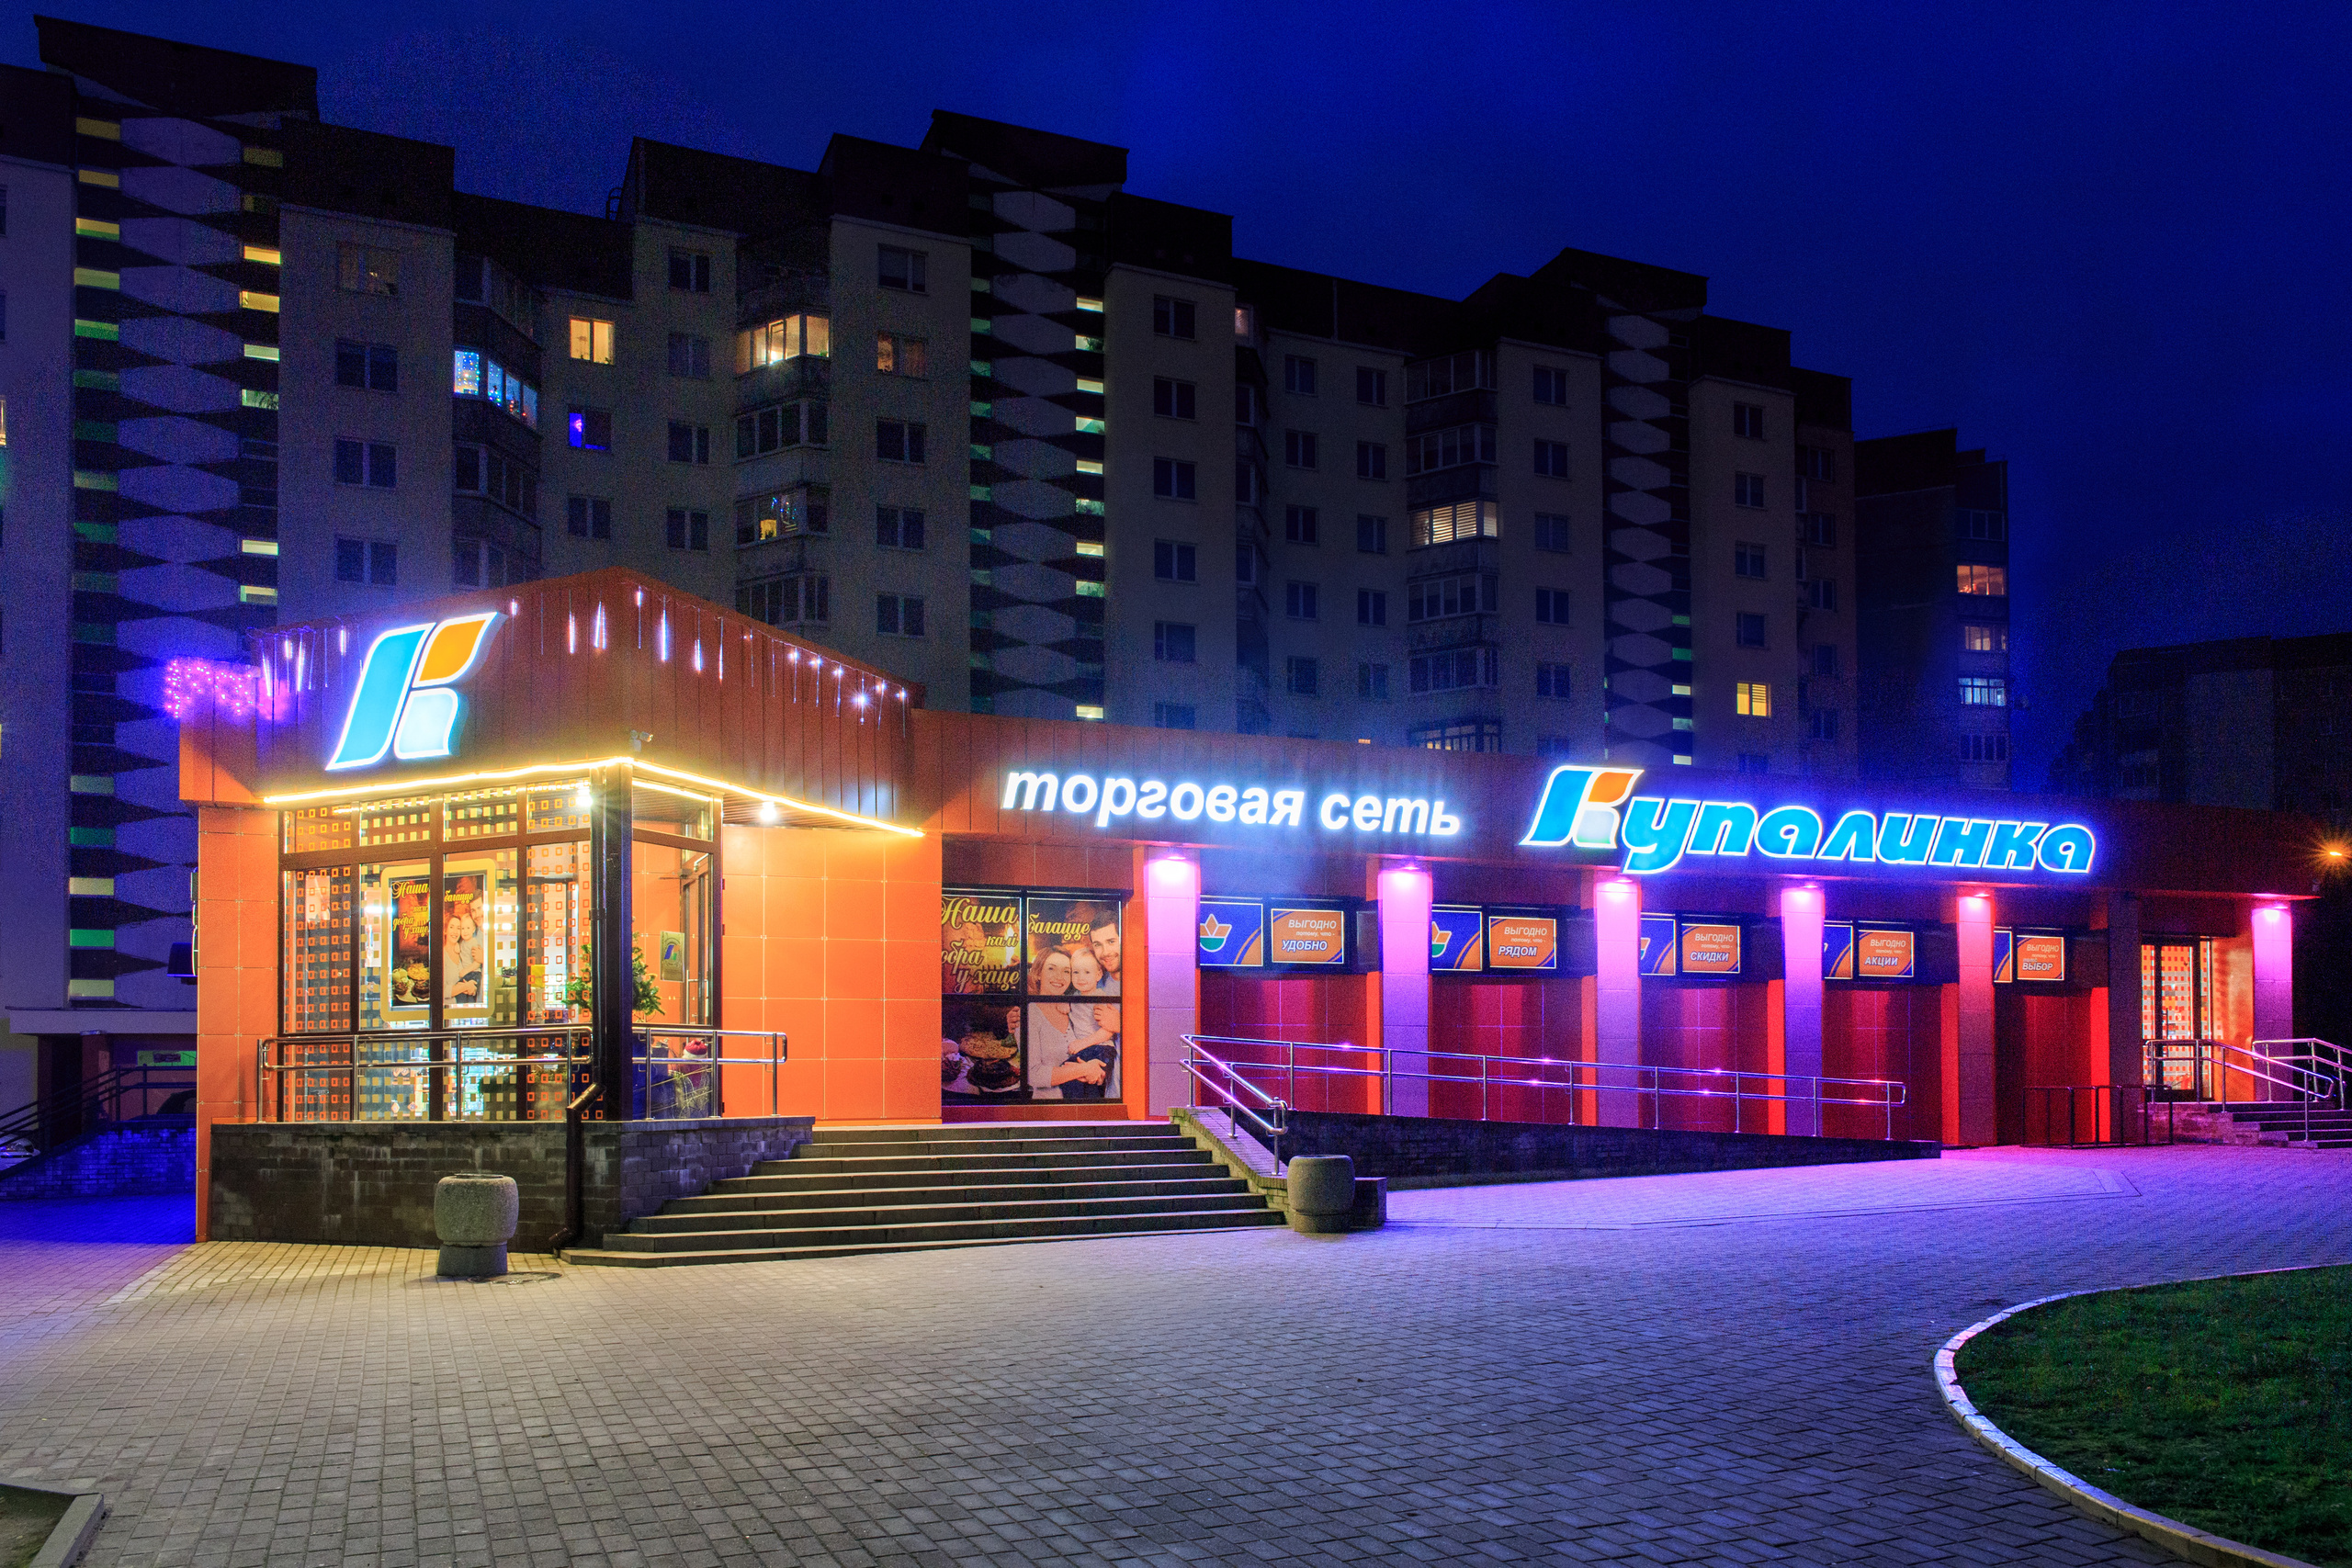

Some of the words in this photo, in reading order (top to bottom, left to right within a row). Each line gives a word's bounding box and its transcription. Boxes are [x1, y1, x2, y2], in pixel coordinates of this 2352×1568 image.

[1001, 771, 1306, 829] торговая
[1320, 792, 1461, 836] сеть
[1519, 764, 2097, 874] Купалинка
[391, 881, 430, 899] Наша
[942, 896, 1019, 930] Наша
[1028, 913, 1091, 941] багацце
[1288, 919, 1337, 931] ВЫГОДНО
[1504, 927, 1547, 937] ВЫГОДНО
[1695, 933, 1735, 942] ВЫГОДНО
[1282, 940, 1328, 953] УДОБНО
[1870, 939, 1906, 948] ВЫГОДНО
[2027, 944, 2059, 953] ВЫГОДНО
[1498, 945, 1538, 958] РЯДОМ
[1690, 952, 1730, 963] СКИДКИ
[942, 941, 984, 975] обра
[1864, 956, 1899, 967] АКЦИИ
[2022, 962, 2053, 971] ВЫБОР
[973, 968, 1020, 990] хаце
